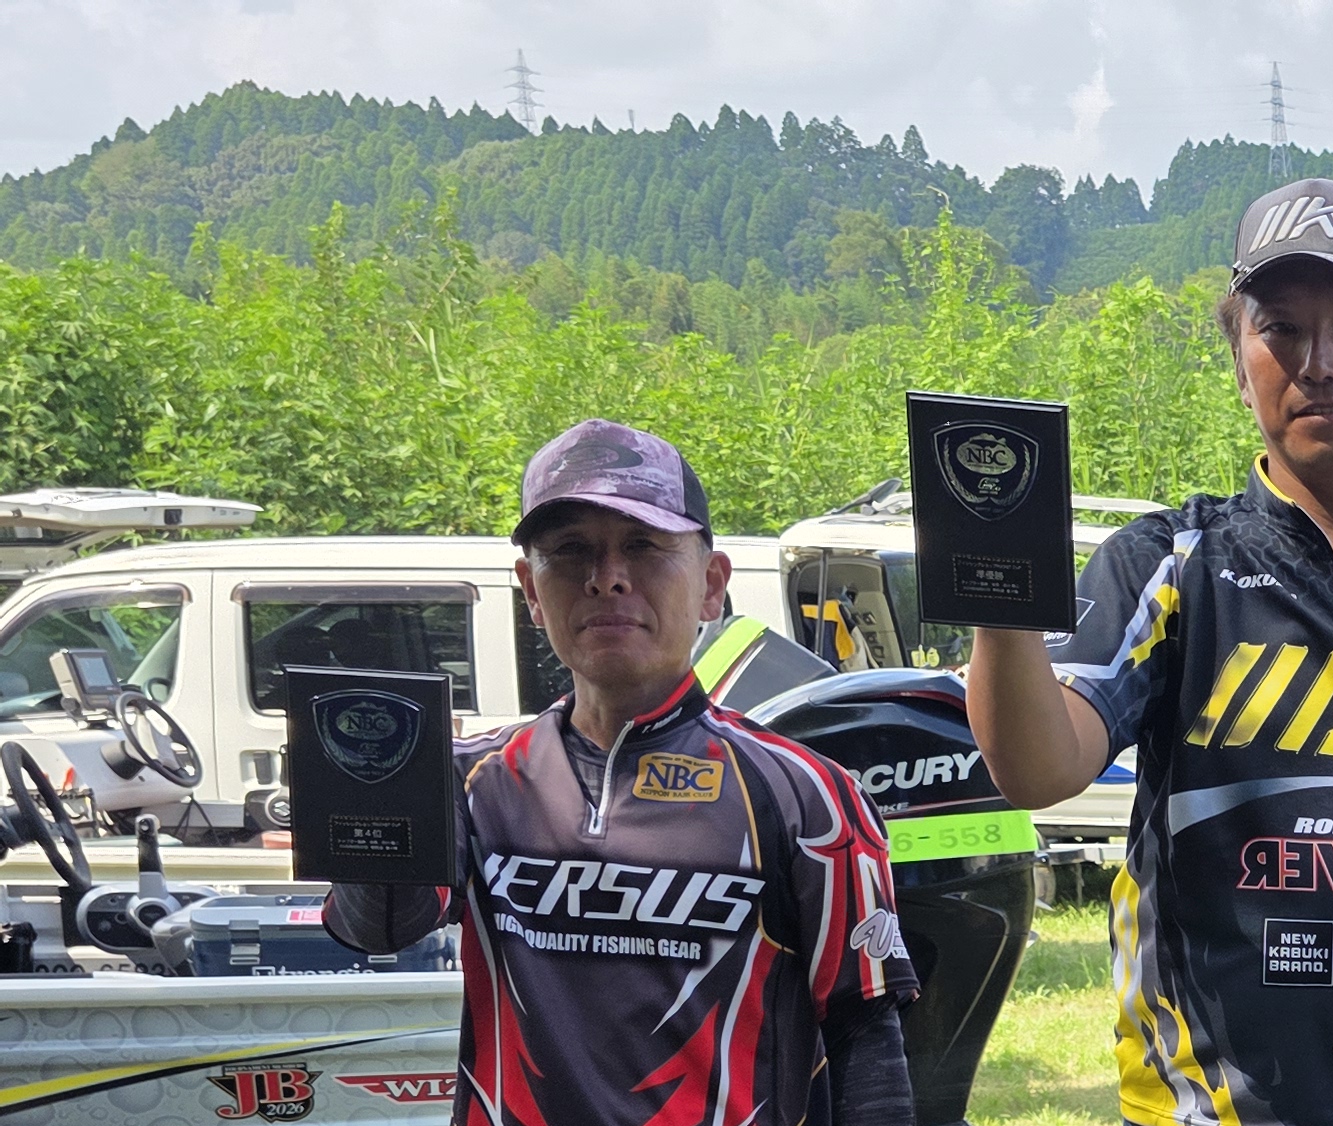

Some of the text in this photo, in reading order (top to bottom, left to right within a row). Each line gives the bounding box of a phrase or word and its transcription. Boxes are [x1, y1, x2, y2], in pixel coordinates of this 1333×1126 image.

[967, 447, 1008, 466] NBC
[346, 717, 387, 732] NBC
[641, 762, 715, 791] NBC
[353, 828, 383, 838] 第4位
[524, 928, 590, 953] QUALITY
[592, 935, 656, 956] FISHING
[657, 940, 701, 961] GEAR
[1280, 933, 1317, 945] NEW
[1268, 946, 1329, 960] KABUKI
[1269, 960, 1328, 973] BRAND.
[215, 1069, 315, 1119] JB
[265, 1102, 306, 1116] 2026
